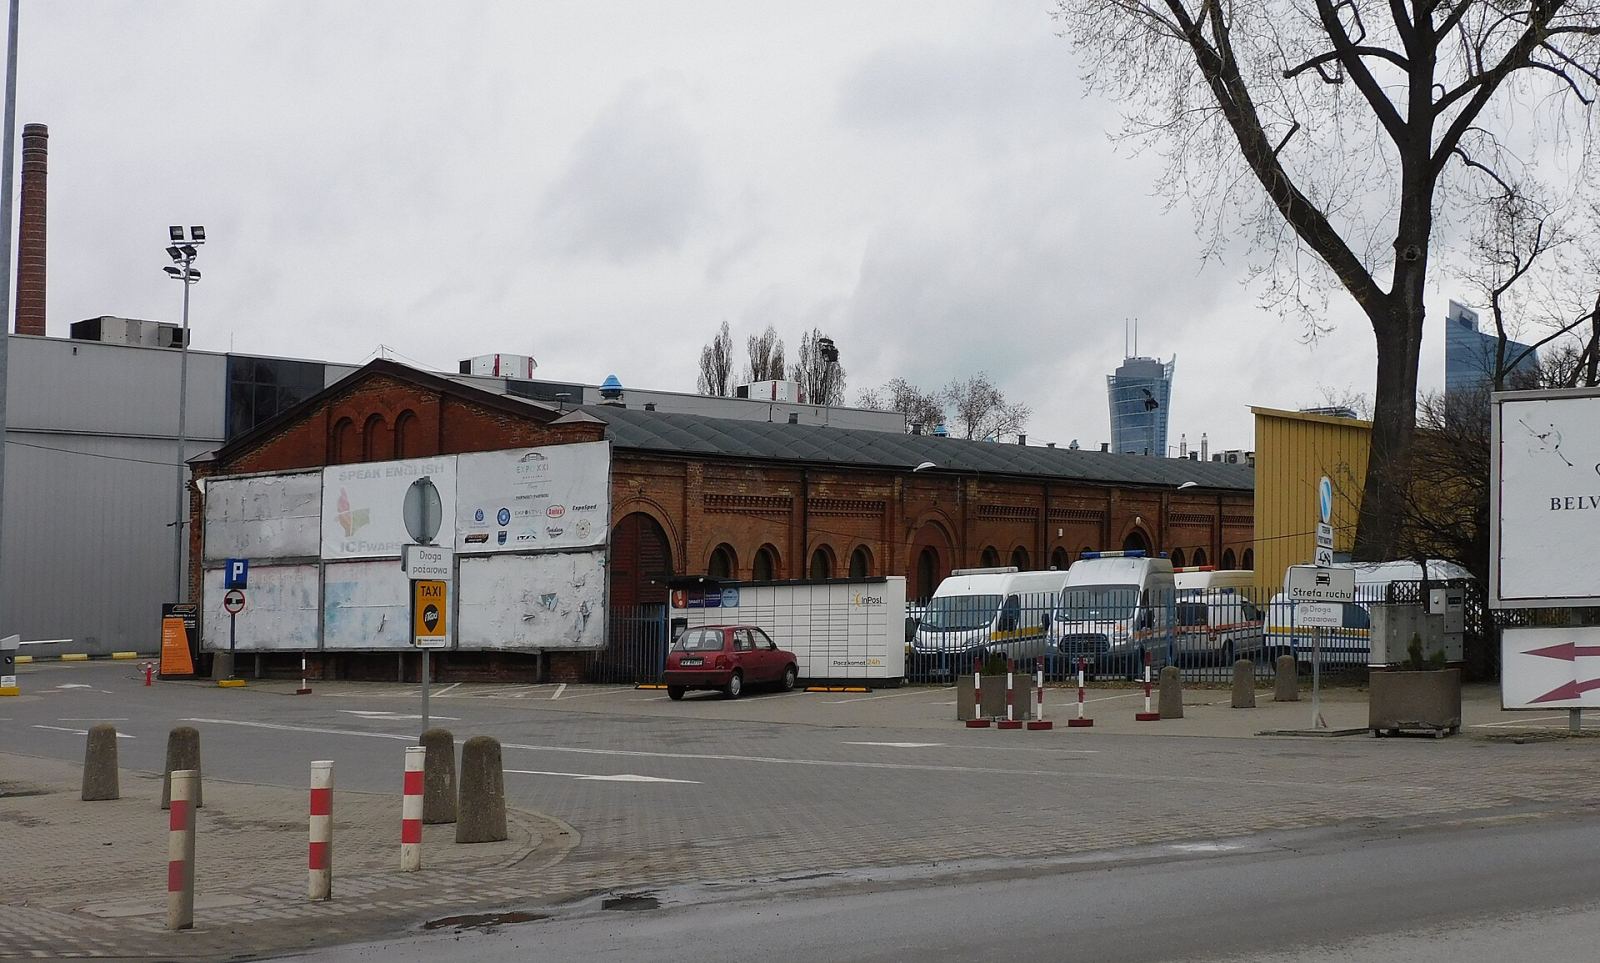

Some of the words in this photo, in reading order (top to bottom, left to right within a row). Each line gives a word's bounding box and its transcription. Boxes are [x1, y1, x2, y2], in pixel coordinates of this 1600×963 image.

[339, 469, 381, 481] SPEAK
[385, 463, 444, 478] ENGLISH
[1550, 496, 1600, 511] BELV
[419, 550, 442, 563] Droga
[232, 562, 244, 581] P
[412, 563, 448, 575] pożarowa
[420, 585, 442, 597] TAXI
[1292, 587, 1322, 598] Strefa
[1325, 588, 1352, 599] ruchu
[1309, 605, 1331, 614] Droga
